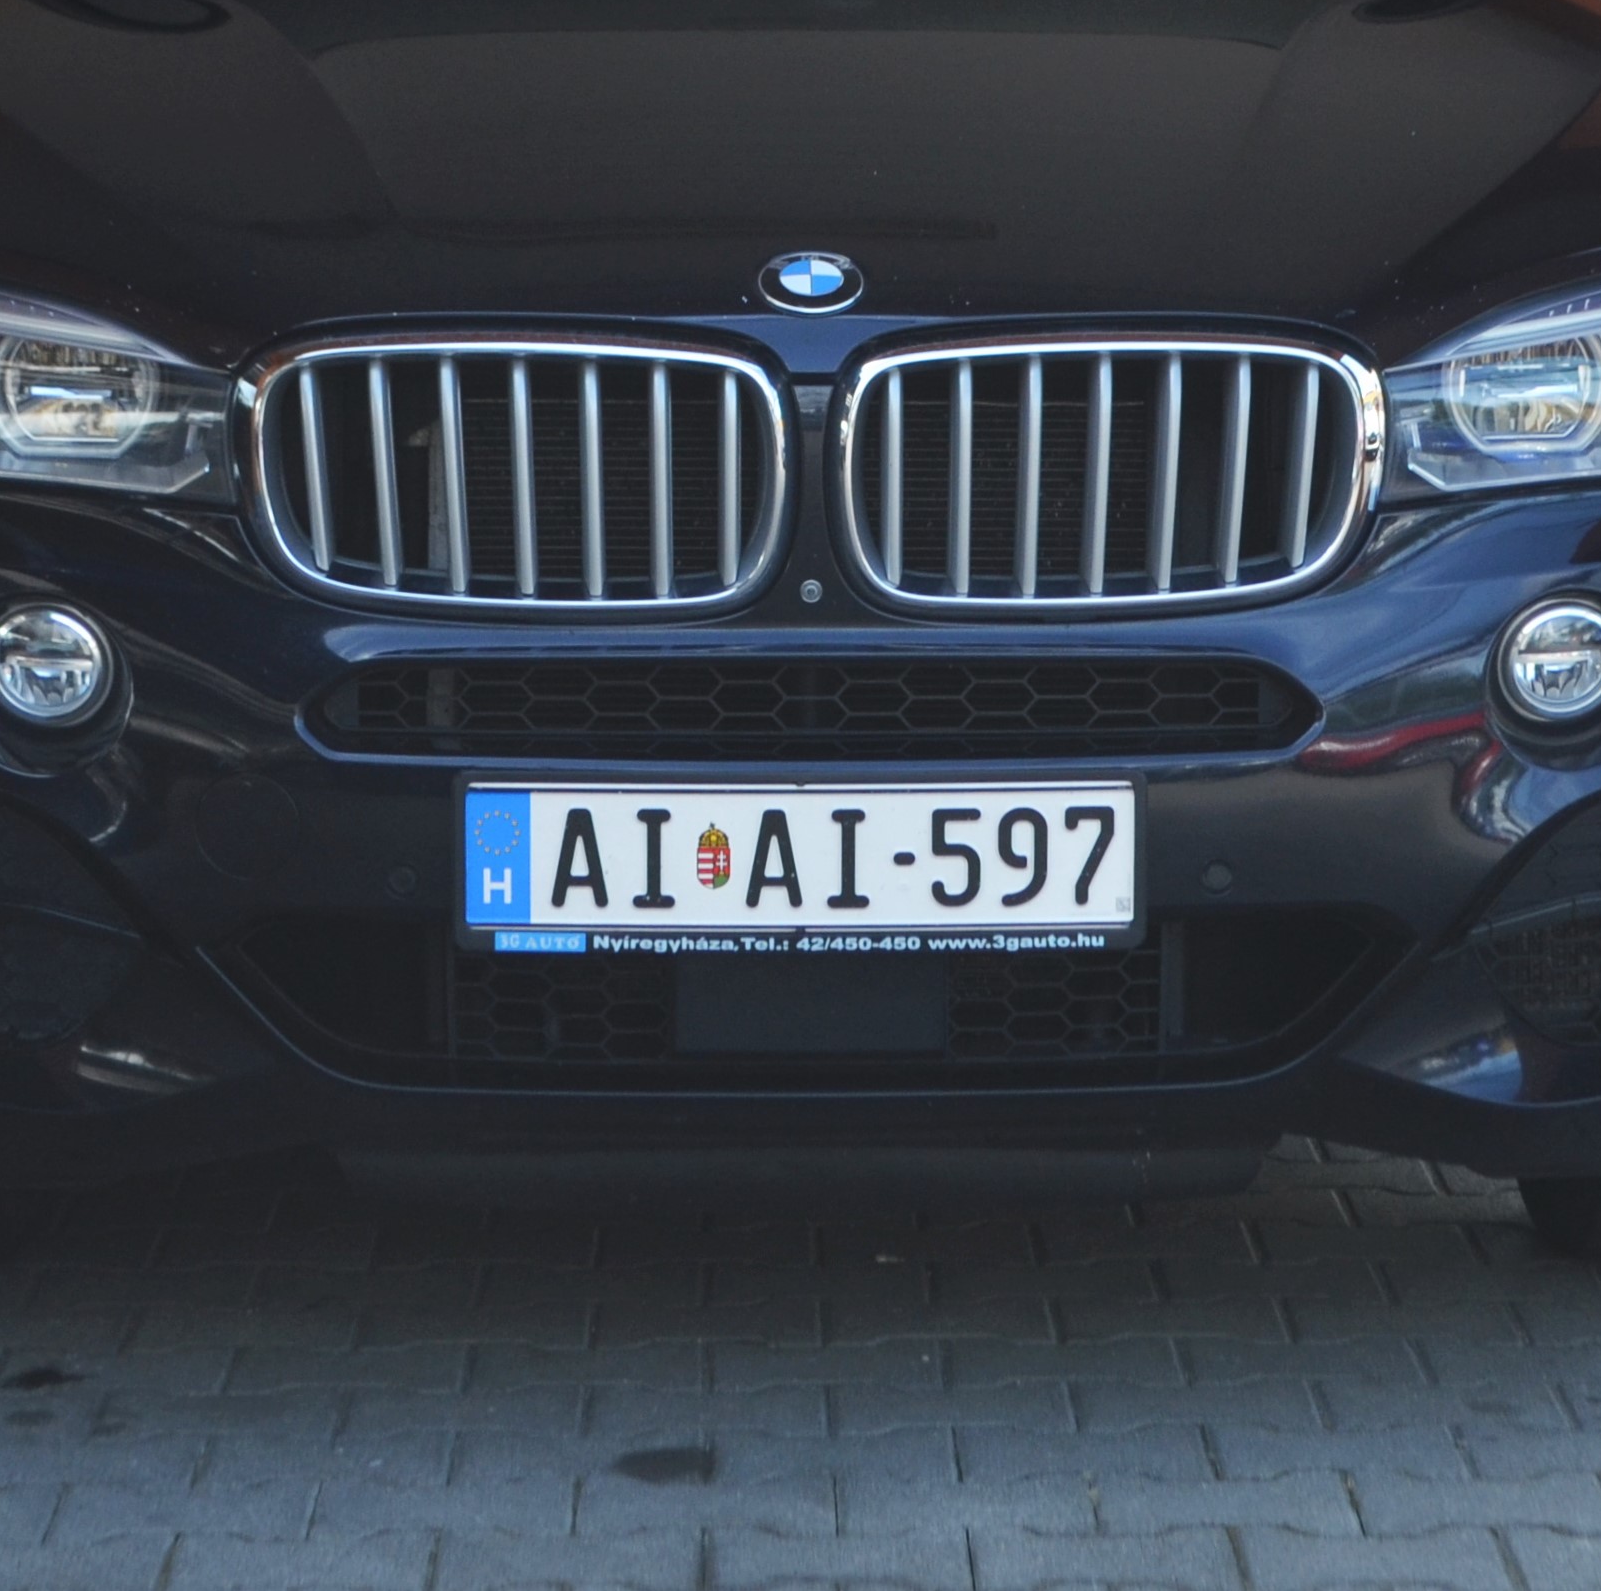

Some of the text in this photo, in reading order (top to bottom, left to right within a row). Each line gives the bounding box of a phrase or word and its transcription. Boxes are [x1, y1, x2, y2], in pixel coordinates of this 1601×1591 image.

[550, 808, 677, 909] AI
[482, 867, 513, 904] H
[796, 935, 921, 952] 42/450-450
[928, 933, 1105, 952] www.3gauto.hu
